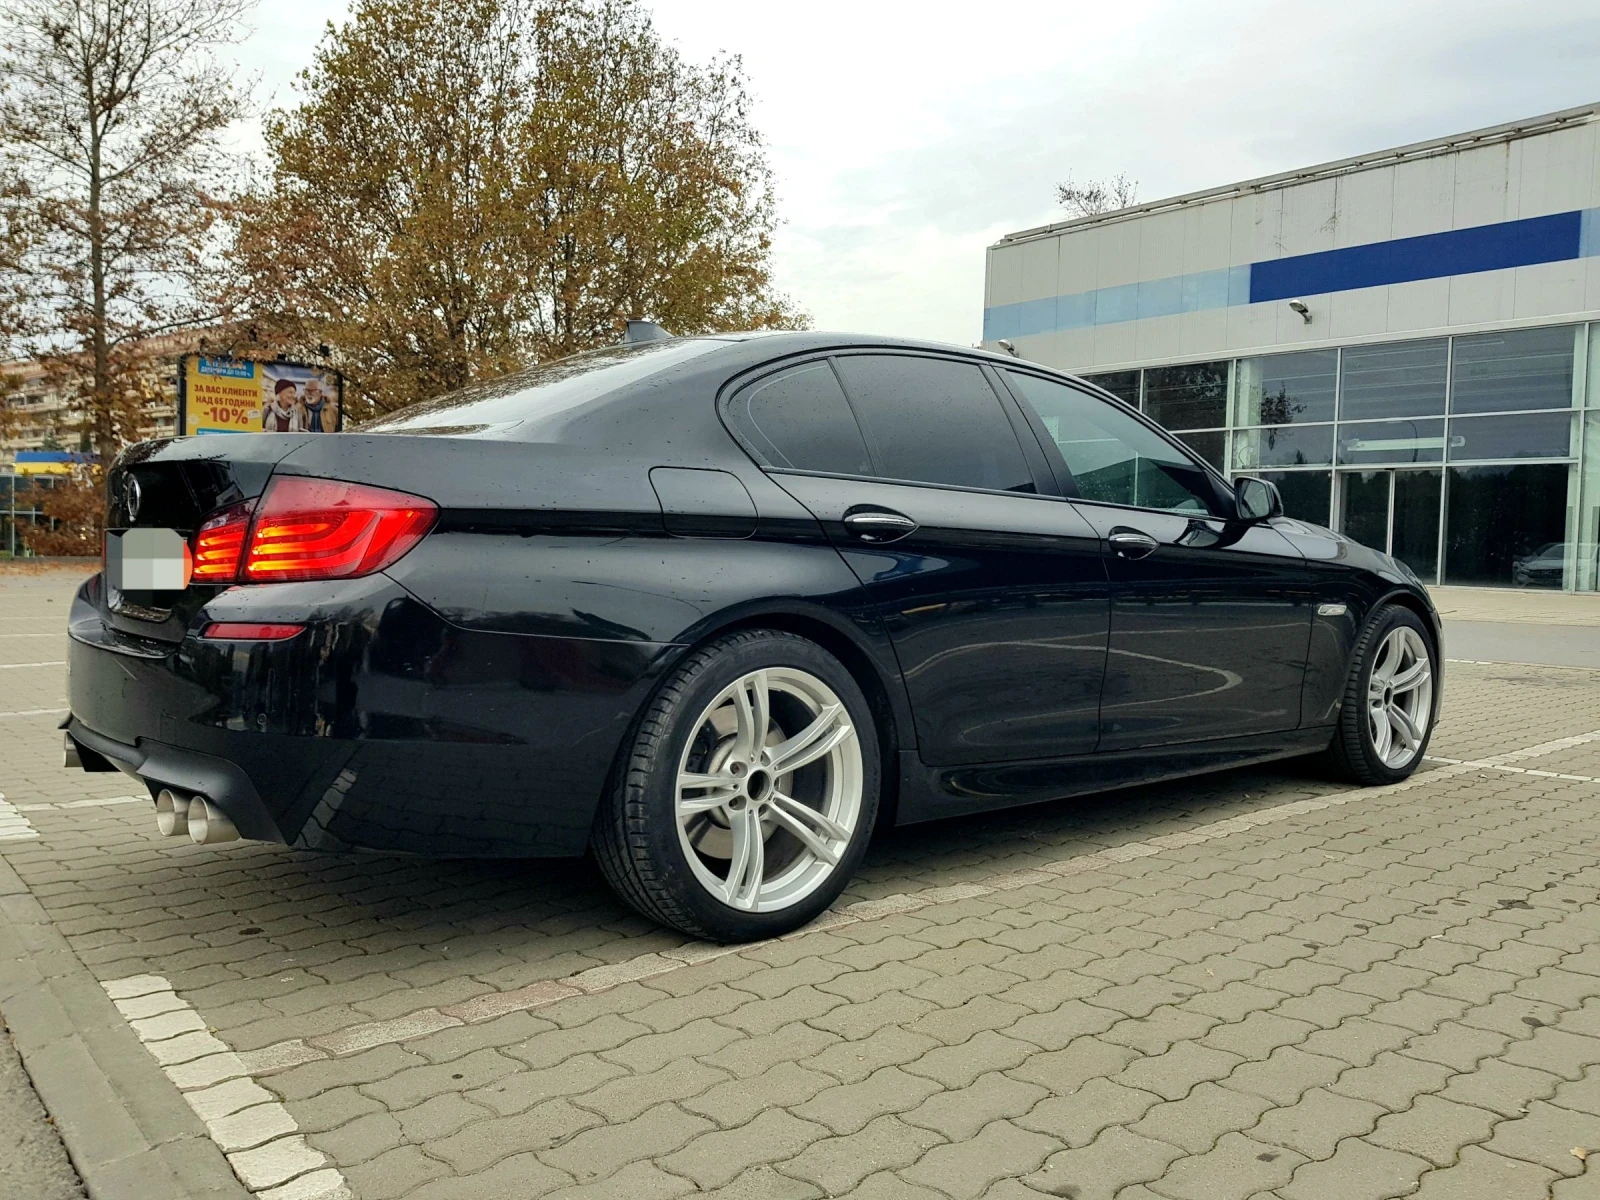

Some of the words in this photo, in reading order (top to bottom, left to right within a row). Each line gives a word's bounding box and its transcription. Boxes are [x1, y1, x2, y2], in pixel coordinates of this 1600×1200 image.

[194, 384, 204, 393] ЗА
[206, 385, 221, 394] ВАС
[222, 386, 258, 398] КЛИЕНТИ
[196, 395, 213, 405] НАД
[214, 397, 223, 405] 65
[224, 398, 256, 408] ГОДИНИ
[203, 406, 249, 424] -10%
